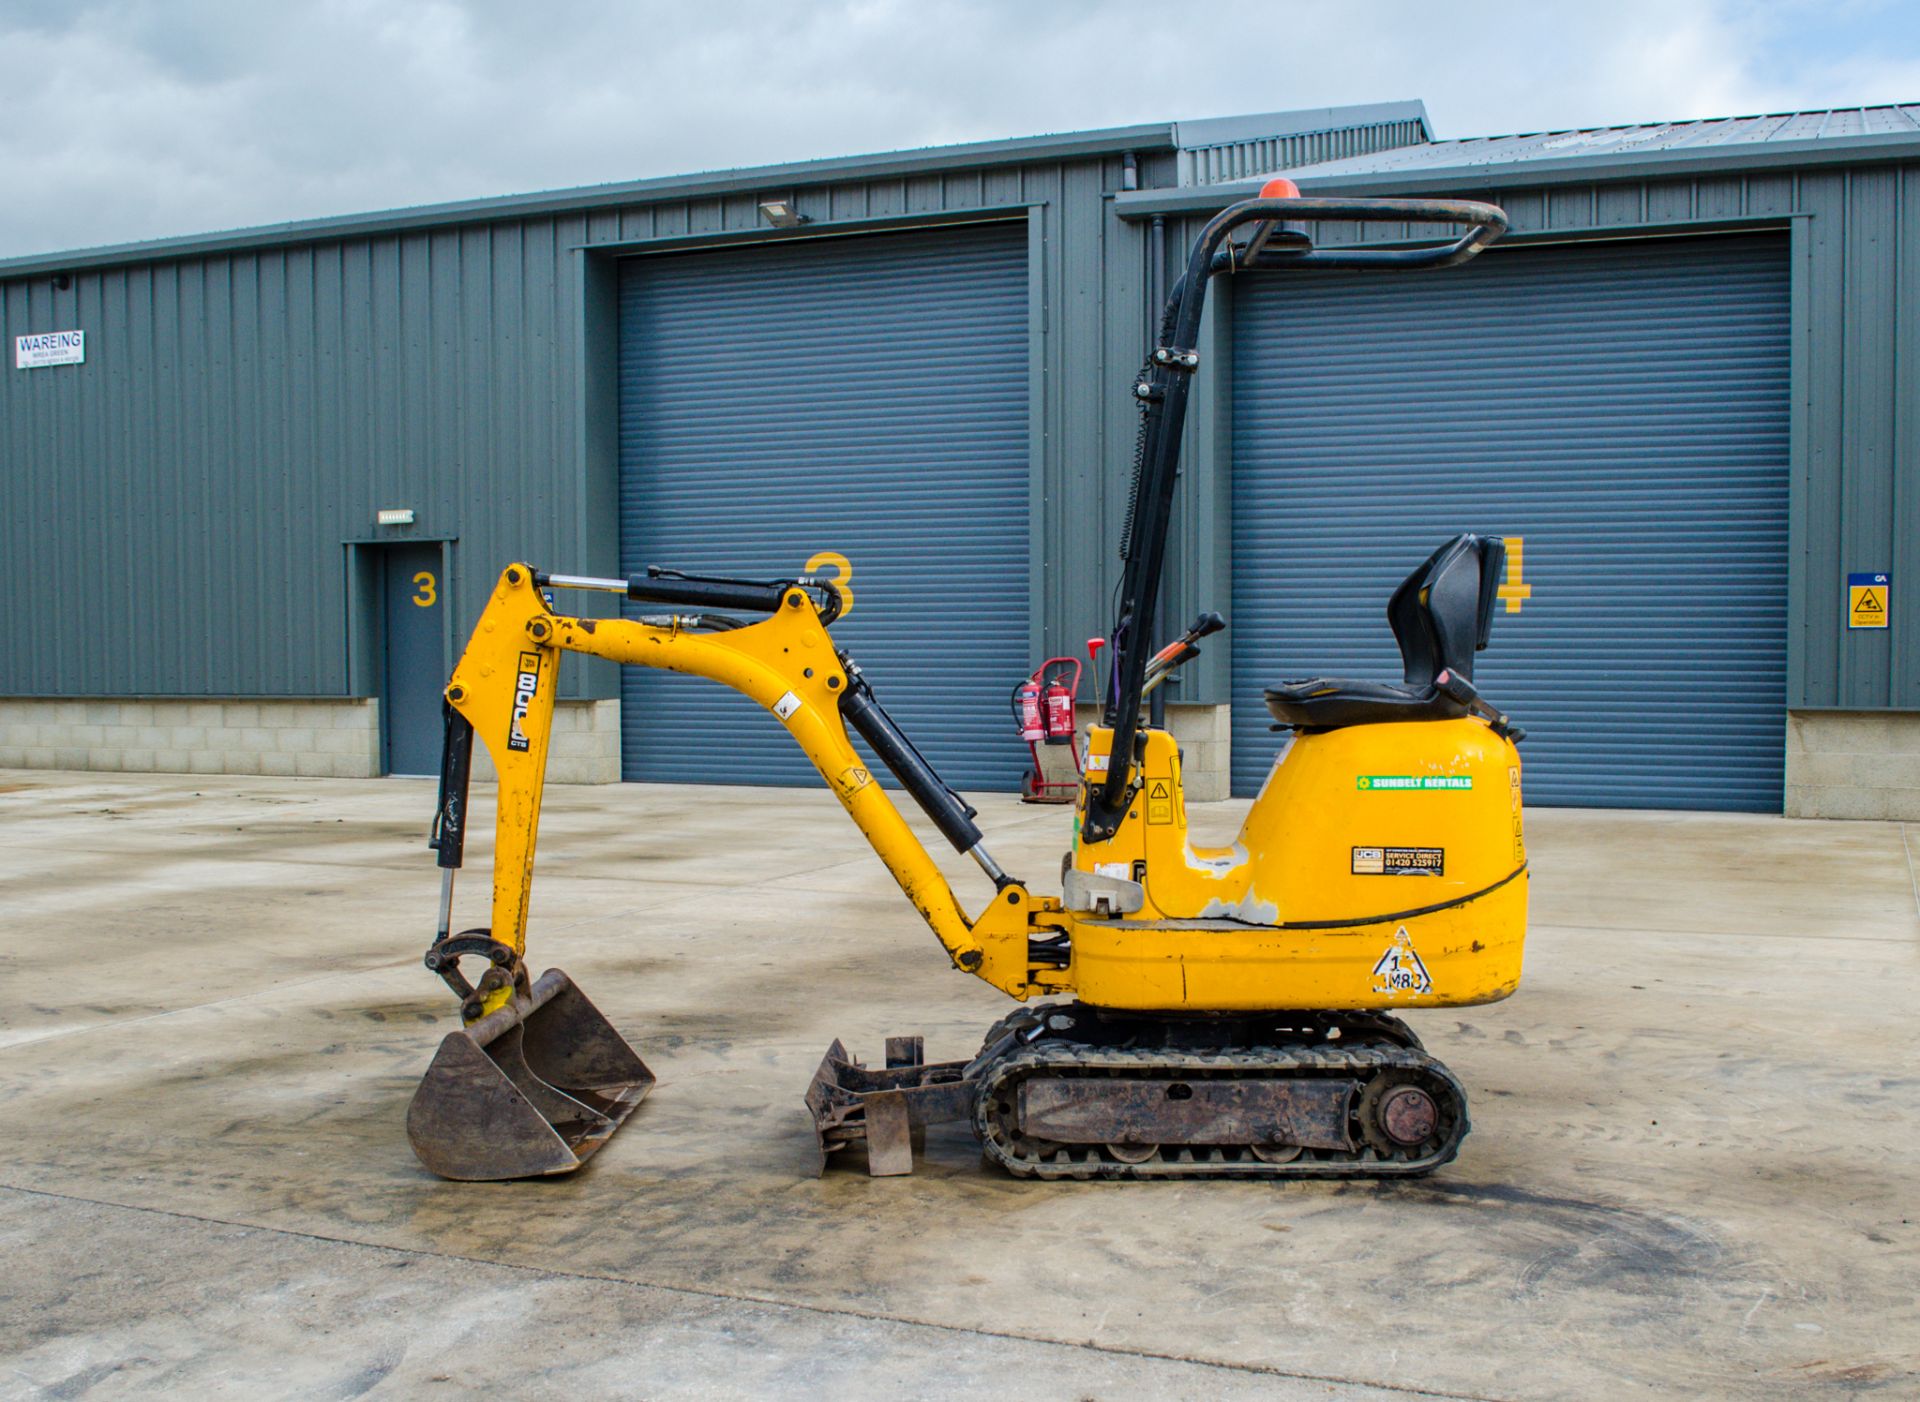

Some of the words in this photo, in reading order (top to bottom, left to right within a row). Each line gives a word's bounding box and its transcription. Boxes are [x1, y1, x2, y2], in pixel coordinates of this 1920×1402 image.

[19, 332, 81, 351] WAREING
[412, 571, 437, 607] 3
[805, 552, 855, 619] 3
[1373, 778, 1422, 787] SUNBELT
[1424, 778, 1472, 787] RENTALS
[1356, 850, 1382, 859] JCB
